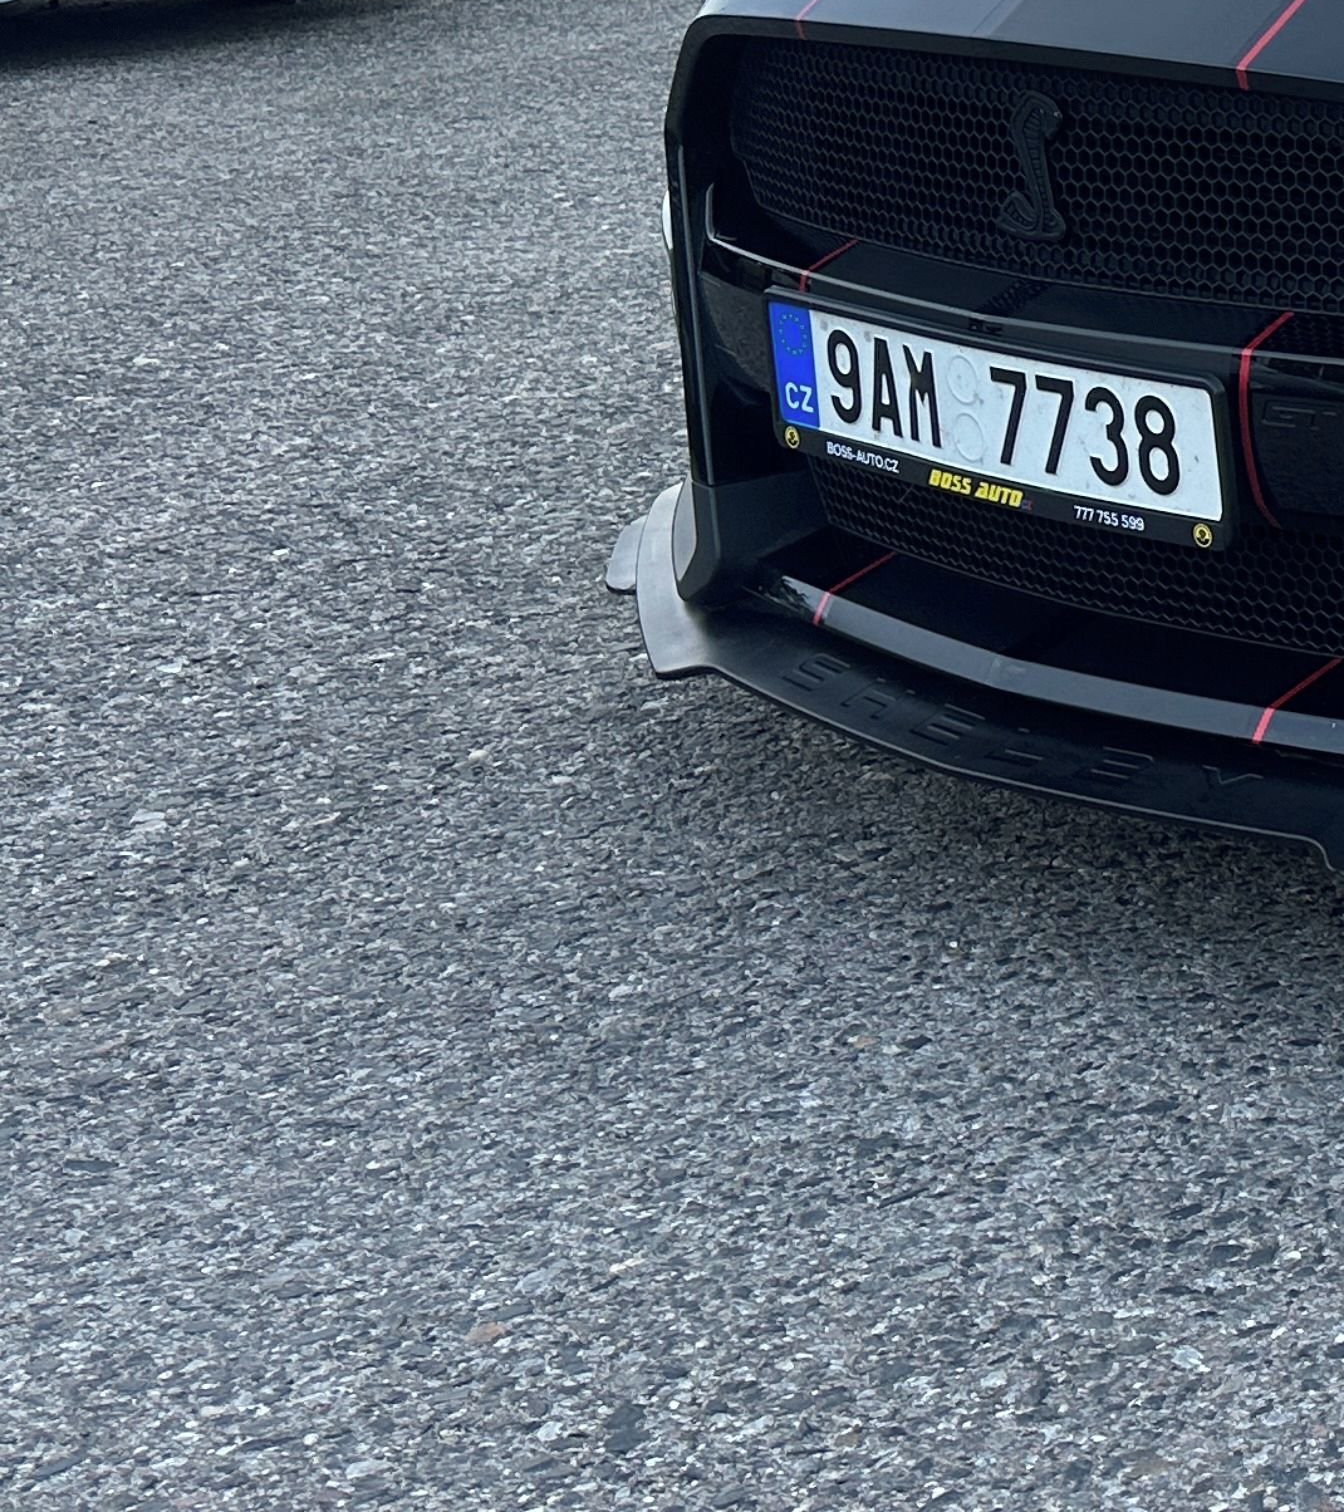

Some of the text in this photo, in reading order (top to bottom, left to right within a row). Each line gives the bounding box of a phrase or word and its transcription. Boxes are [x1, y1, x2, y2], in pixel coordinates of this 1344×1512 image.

[784, 380, 815, 415] CZ
[826, 328, 1181, 496] 9AM 7738
[826, 440, 901, 474] BOSS-AUTO.CZ
[928, 468, 972, 495] BOSS
[974, 481, 1024, 508] AUTO
[1073, 504, 1145, 531] 777 755 599
